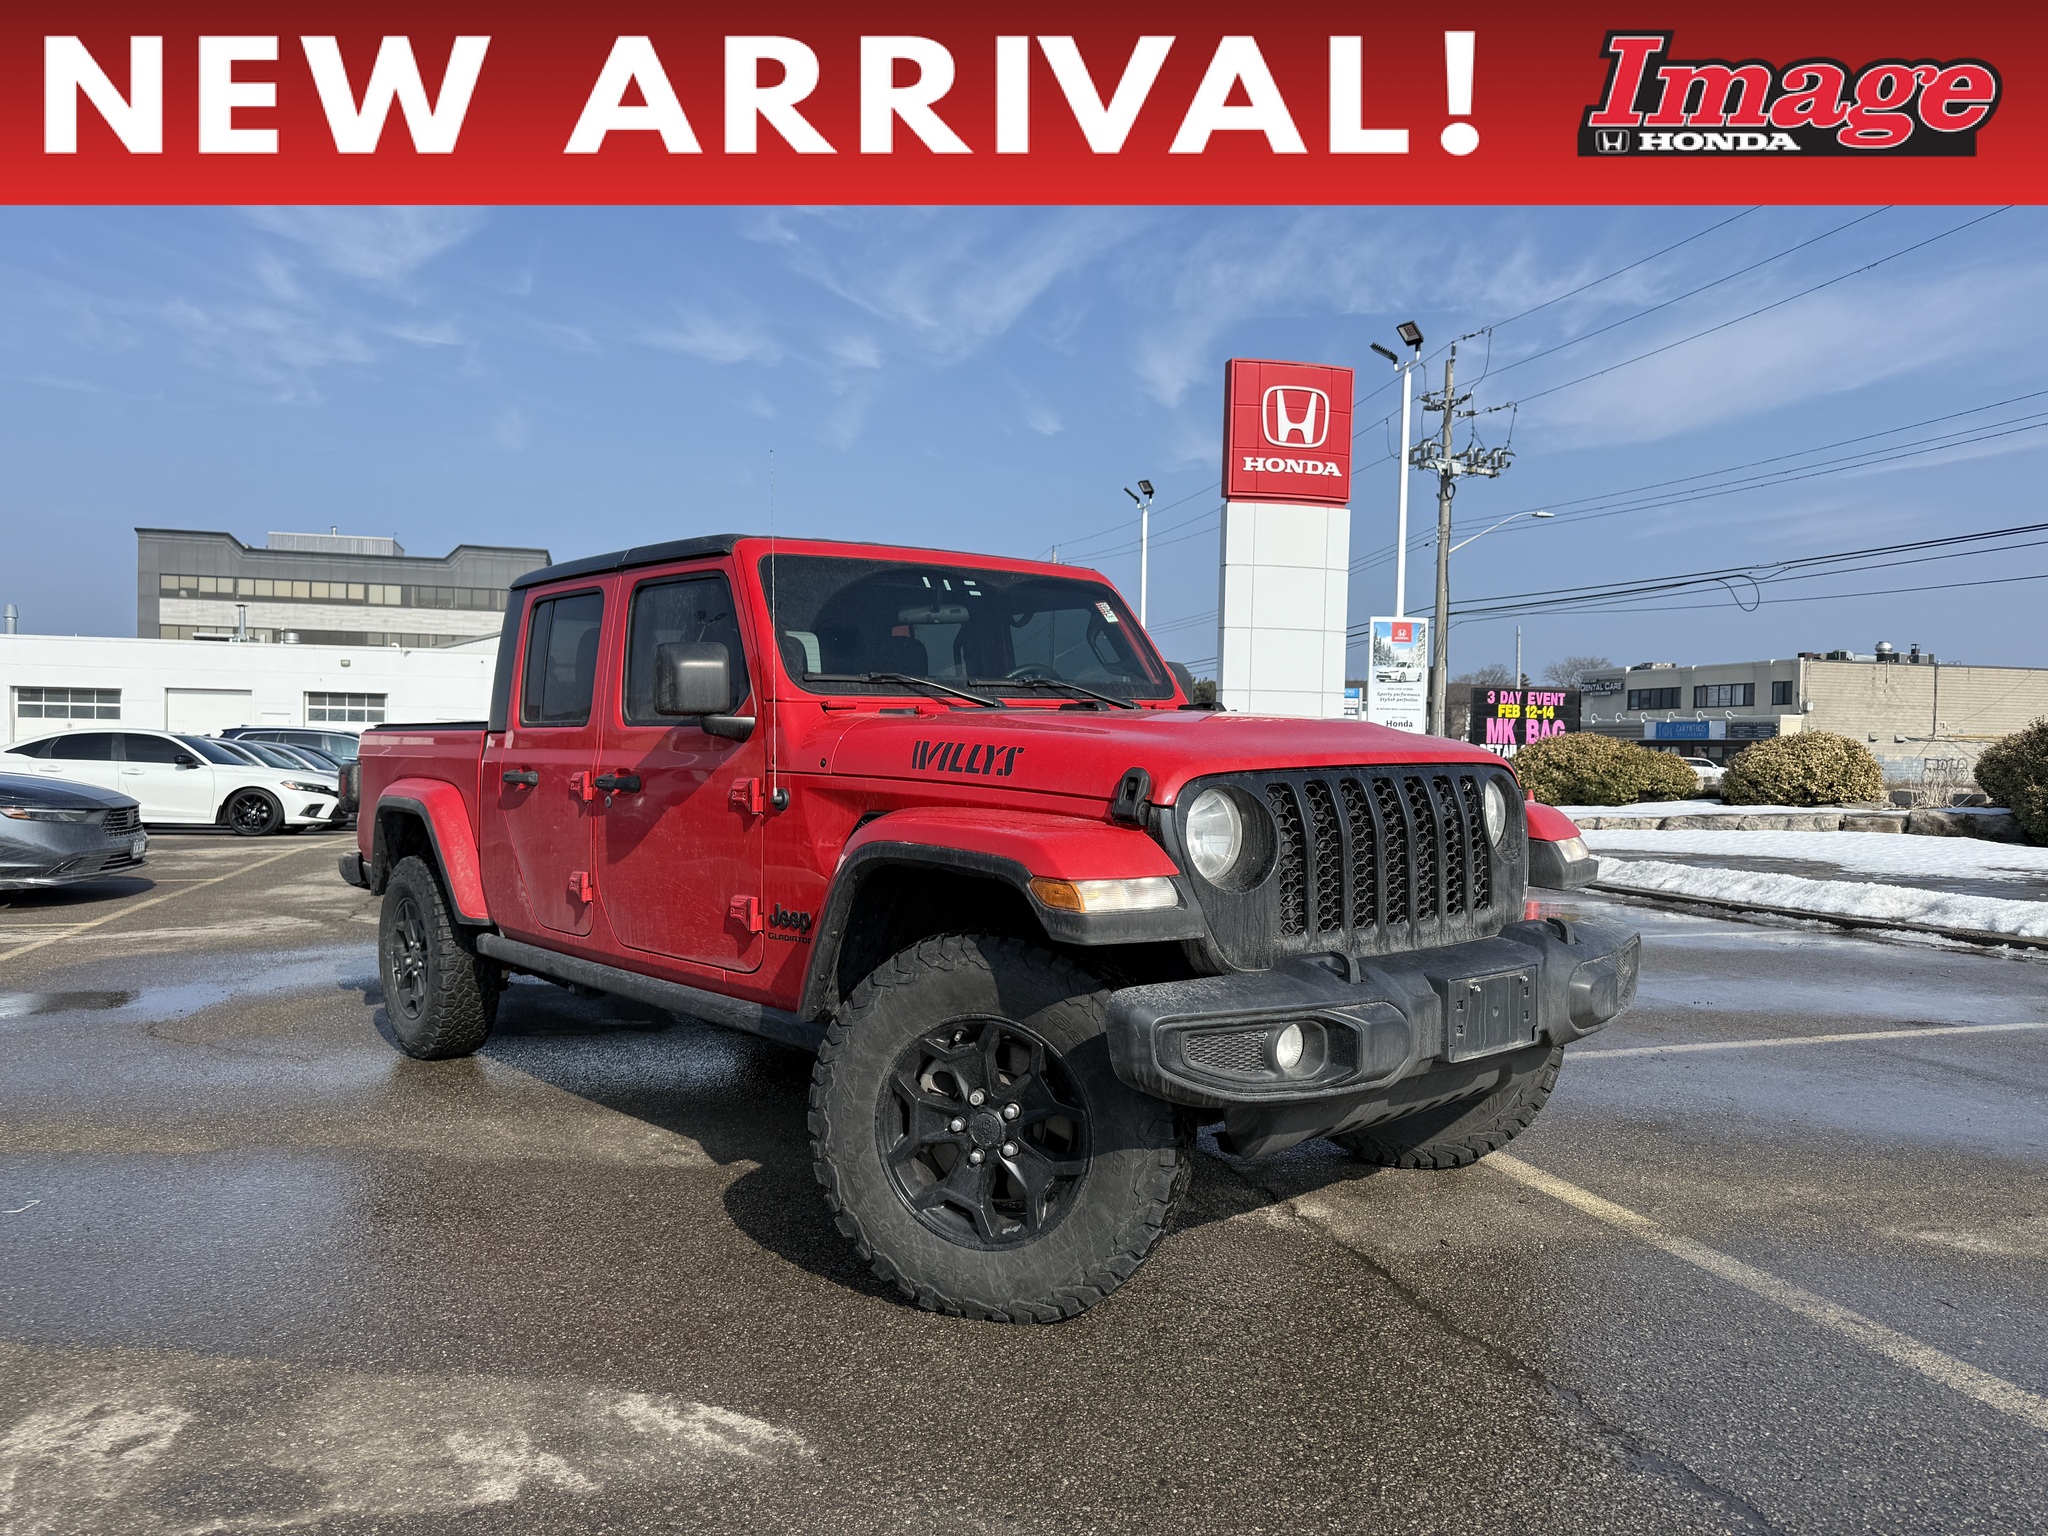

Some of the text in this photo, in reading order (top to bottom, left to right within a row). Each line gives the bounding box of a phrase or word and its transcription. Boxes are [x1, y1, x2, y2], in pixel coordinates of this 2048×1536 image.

[1241, 456, 1343, 478] HONDA
[1486, 690, 1566, 707] 3 DAY EVENT
[1497, 703, 1555, 720] FEB 12-14
[1386, 719, 1413, 728] Honda
[1486, 717, 1517, 745] MK
[911, 740, 1026, 777] WILLYS
[769, 902, 812, 935] Jeep
[767, 932, 812, 945] GLADIATOR
